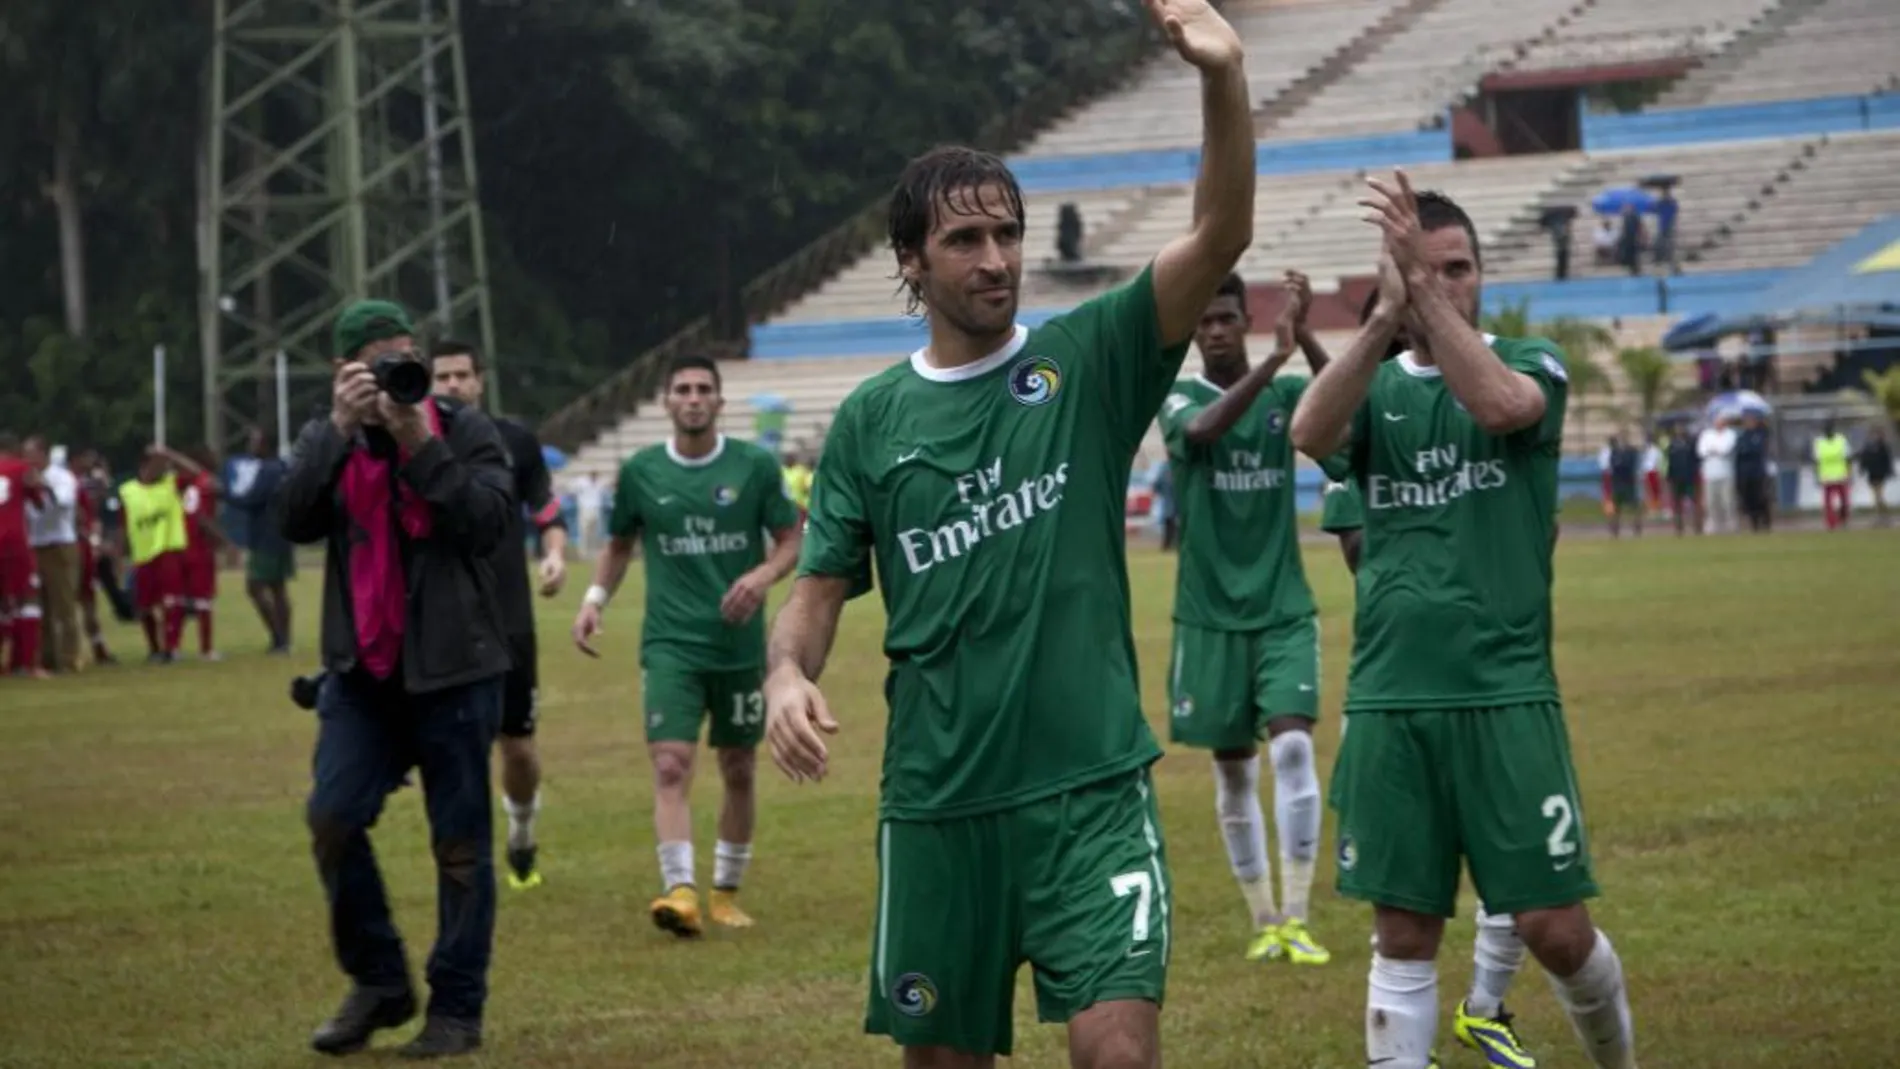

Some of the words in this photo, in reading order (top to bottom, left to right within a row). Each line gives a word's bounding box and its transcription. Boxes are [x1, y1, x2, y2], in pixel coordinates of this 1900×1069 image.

[1368, 459, 1507, 509] Emirates
[731, 690, 763, 725] 13
[1541, 794, 1578, 857] 2
[1109, 871, 1151, 942] 7
